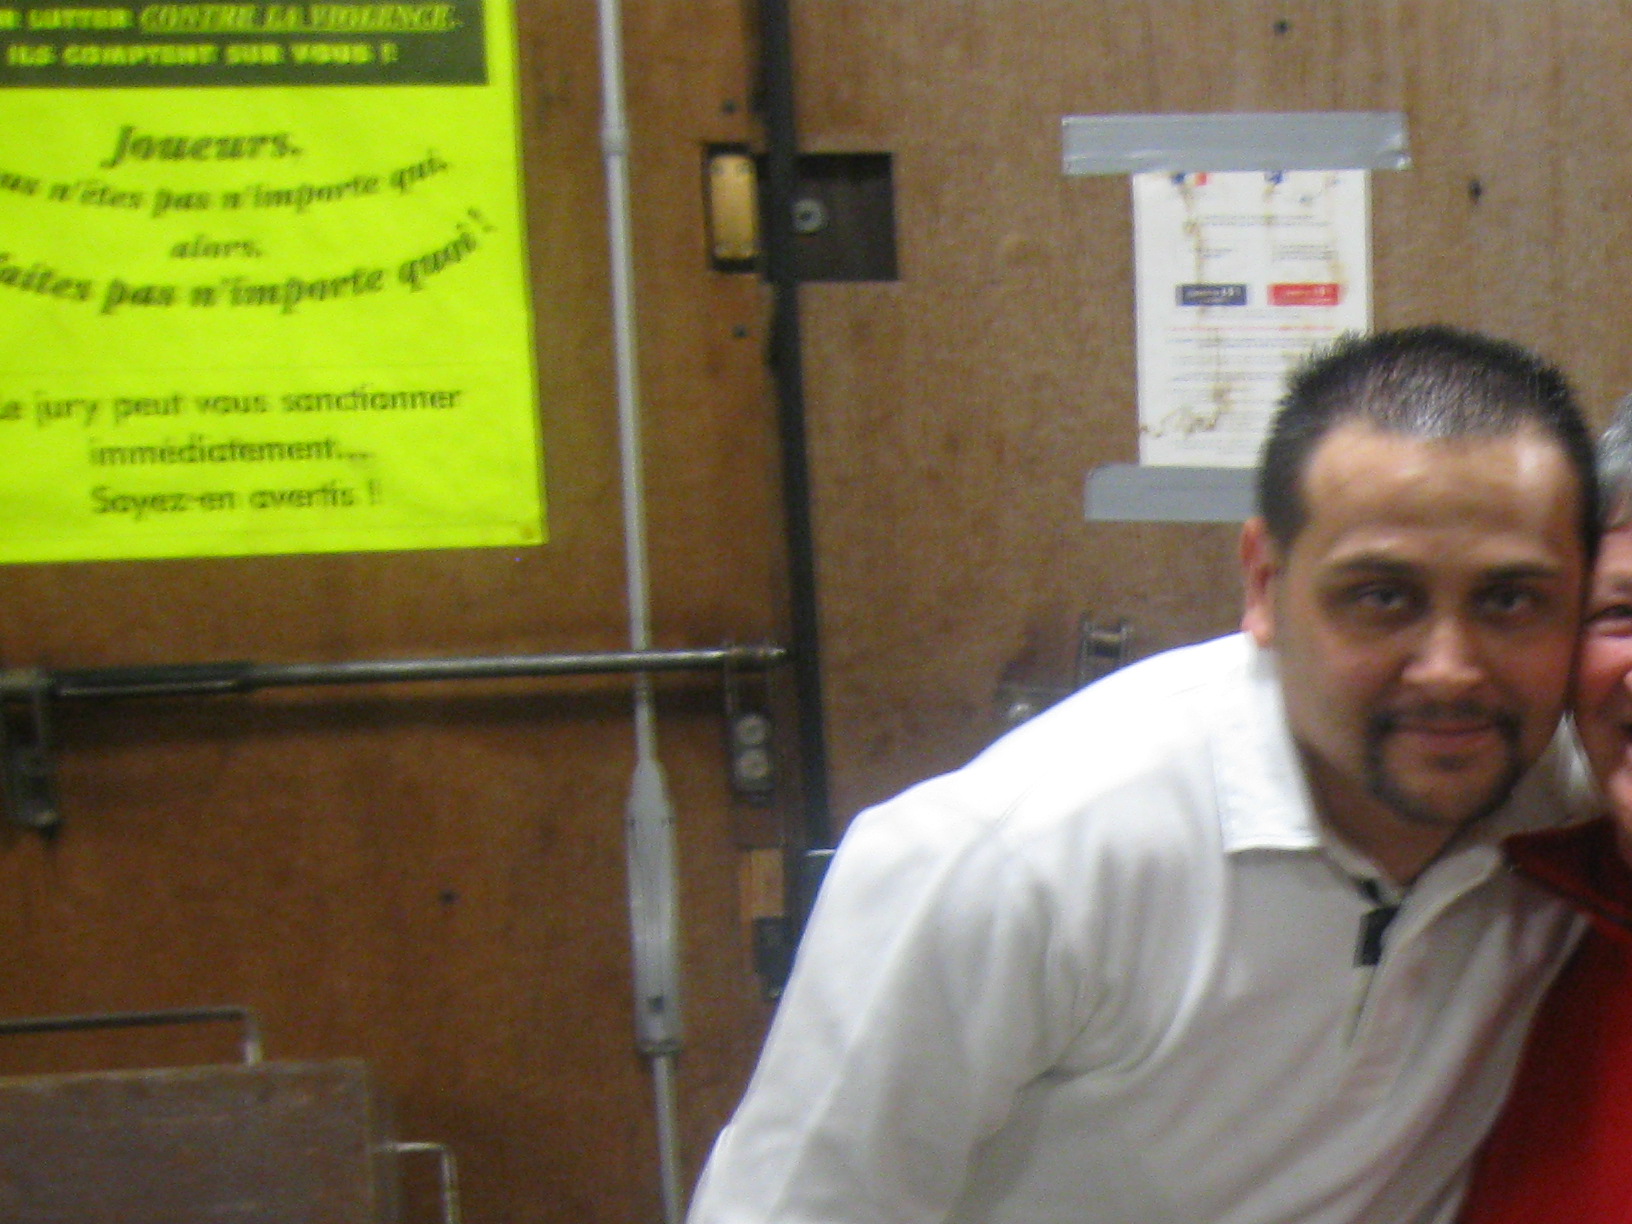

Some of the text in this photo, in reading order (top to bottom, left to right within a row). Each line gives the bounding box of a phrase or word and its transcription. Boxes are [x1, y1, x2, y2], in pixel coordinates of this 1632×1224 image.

[62, 44, 218, 66] COMPTENT
[226, 43, 283, 65] SUR
[291, 43, 374, 65] VOUS
[151, 187, 211, 219] pas
[0, 251, 92, 301] aites
[101, 278, 176, 316] pas
[33, 390, 98, 430] jury
[112, 393, 181, 427] peut
[195, 394, 268, 413] vous
[281, 382, 464, 413] sanctionner
[249, 480, 355, 509] avertis
